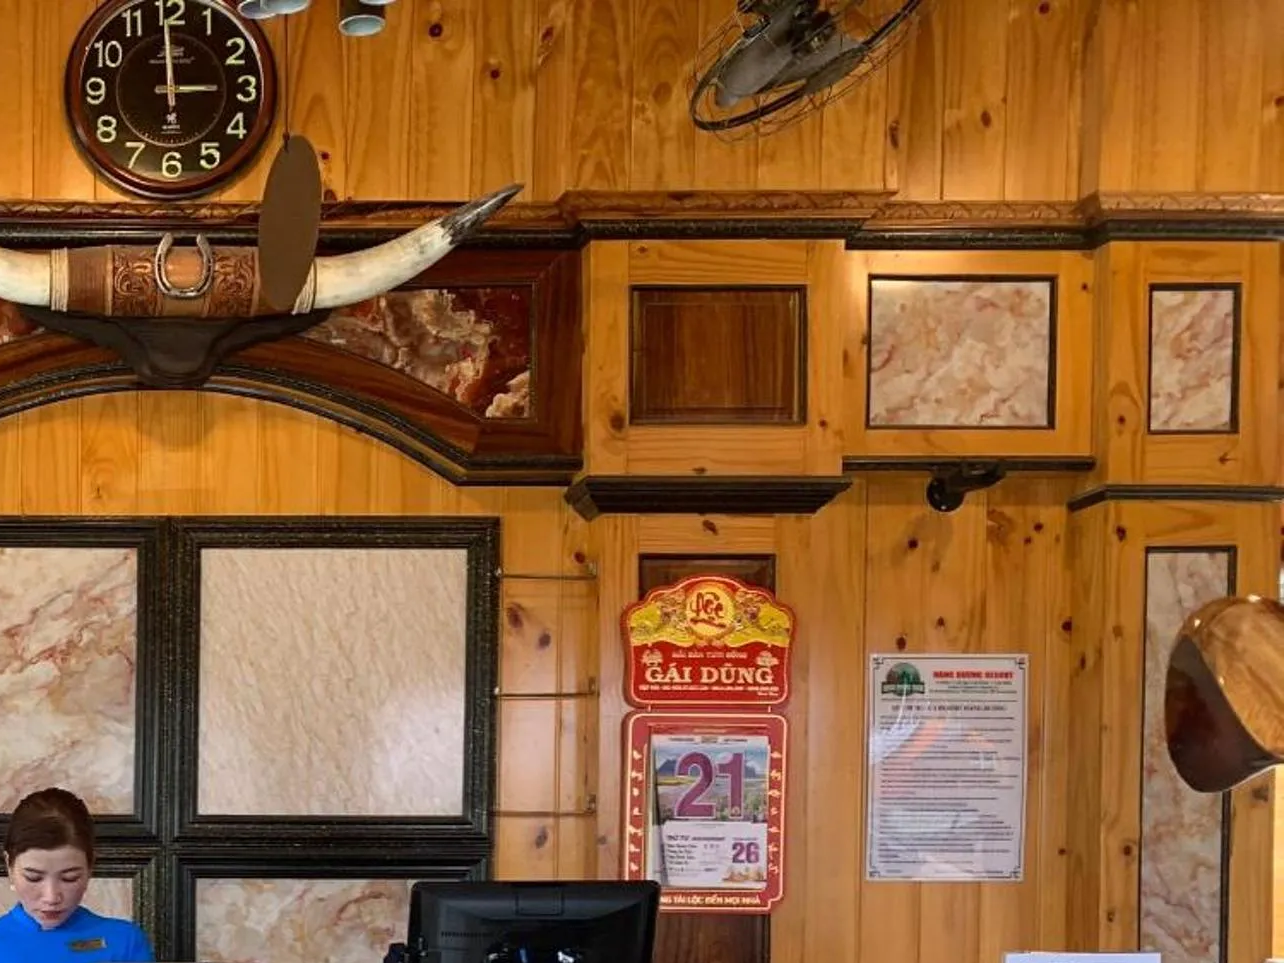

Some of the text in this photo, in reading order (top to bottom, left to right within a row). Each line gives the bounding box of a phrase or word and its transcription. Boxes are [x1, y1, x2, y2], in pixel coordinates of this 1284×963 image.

[122, 9, 143, 37] 11
[155, 0, 186, 26] 12
[202, 8, 212, 36] 1
[94, 40, 123, 68] 10
[225, 37, 246, 65] 2
[86, 77, 106, 105] 9
[236, 75, 257, 102] 3
[96, 115, 117, 143] 8
[226, 112, 247, 140] 4
[125, 142, 146, 169] 7
[162, 151, 182, 178] 6
[199, 142, 220, 169] 5
[645, 663, 774, 685] GÁI DŨNG
[675, 751, 745, 819] 21
[731, 842, 760, 864] 26
